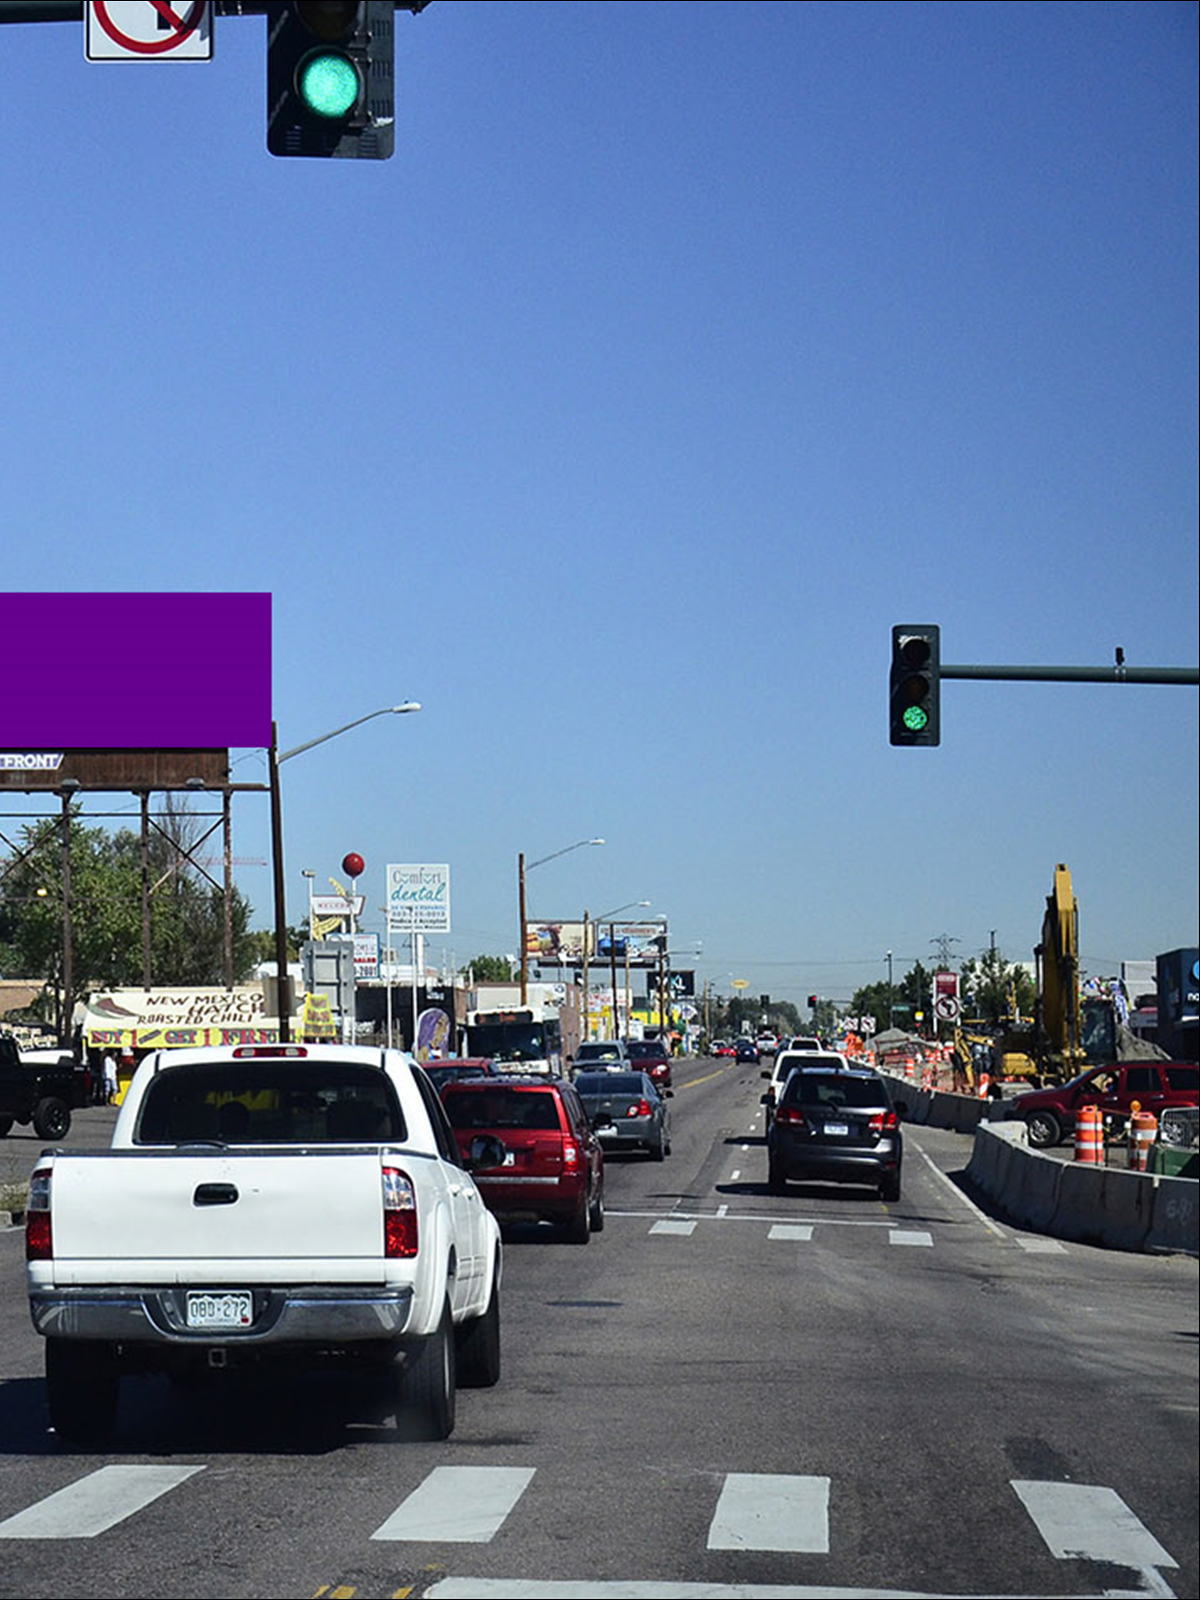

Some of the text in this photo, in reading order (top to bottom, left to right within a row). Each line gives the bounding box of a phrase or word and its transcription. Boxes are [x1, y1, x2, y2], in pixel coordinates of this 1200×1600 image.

[391, 882, 446, 902] dental
[146, 992, 263, 1006] NEW MEXICO
[188, 1001, 265, 1017] HATCH
[137, 1012, 253, 1025] ROASTED CHILI
[91, 1030, 123, 1044] BUY
[131, 1029, 137, 1047] 1
[164, 1029, 197, 1044] GET
[202, 1028, 211, 1046] 1
